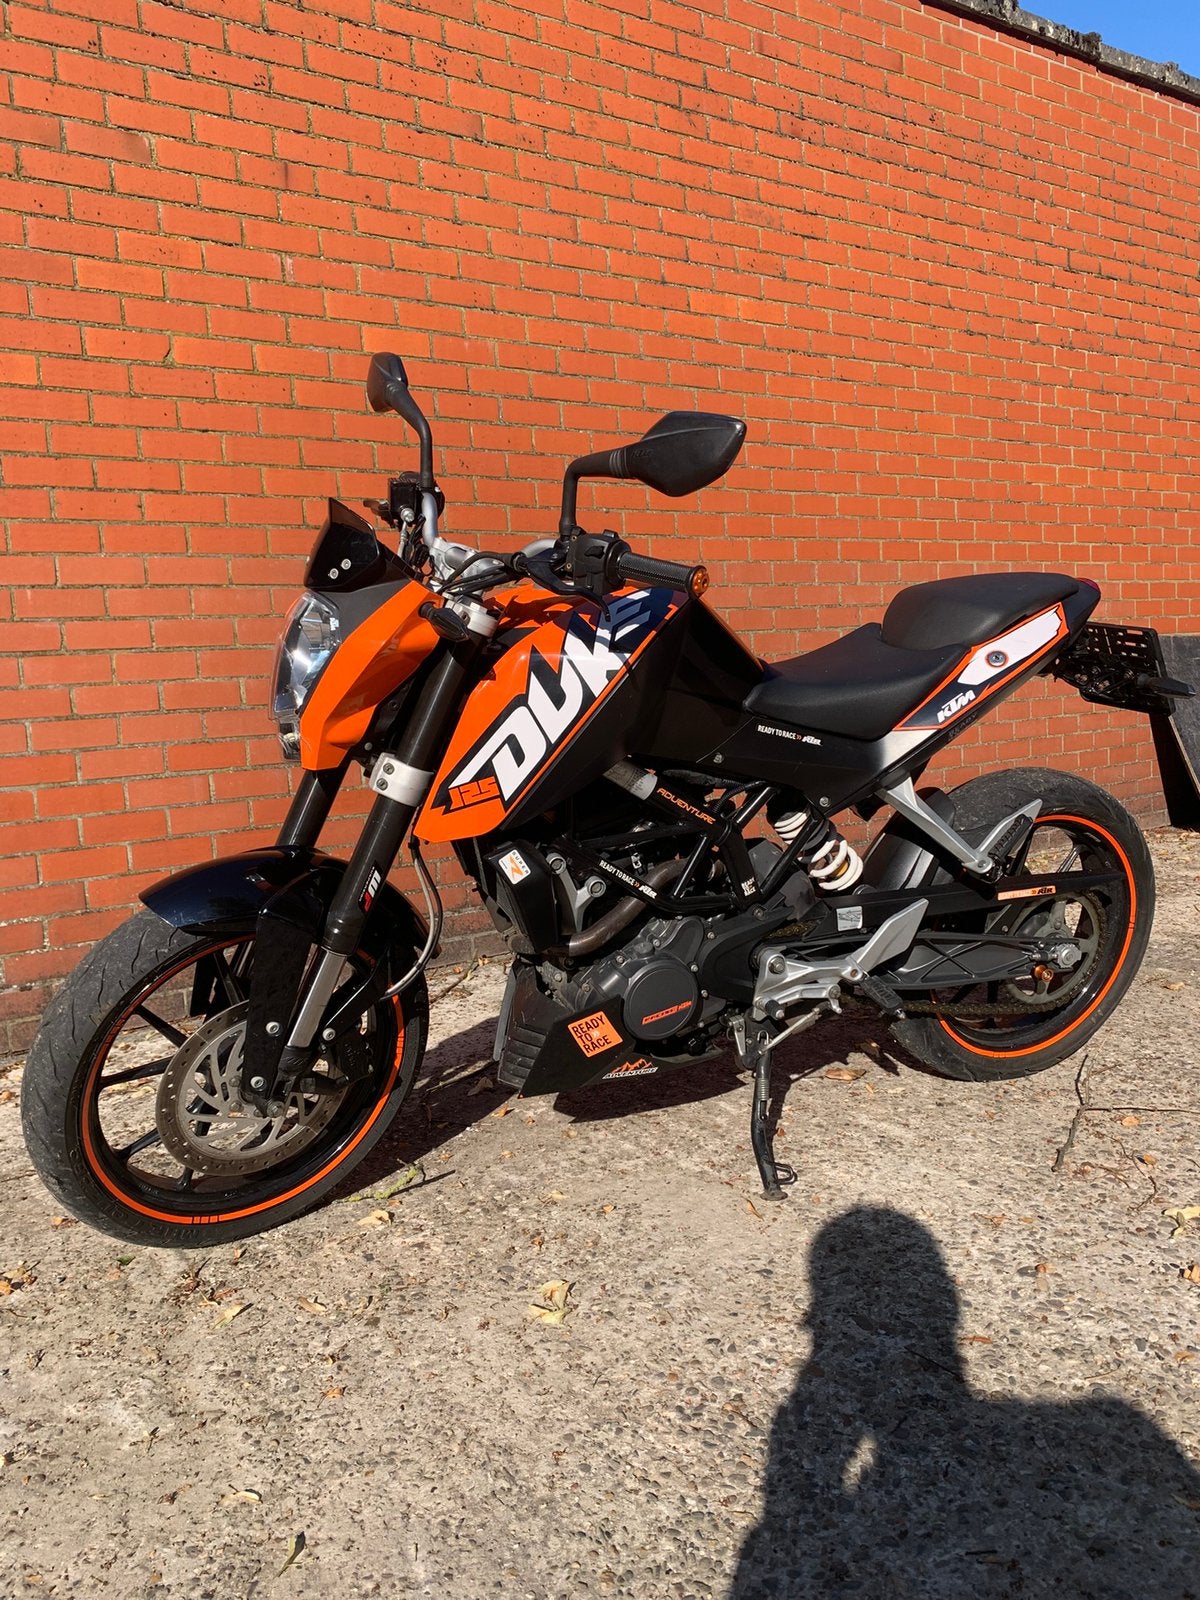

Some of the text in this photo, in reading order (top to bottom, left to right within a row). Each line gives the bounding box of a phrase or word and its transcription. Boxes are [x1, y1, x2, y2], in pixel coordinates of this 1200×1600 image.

[448, 587, 652, 801] DUKE
[936, 689, 976, 723] KTM
[758, 724, 775, 735] READY
[776, 728, 782, 737] TO
[782, 730, 796, 740] RACE
[448, 776, 500, 810] 125
[599, 859, 616, 874] READY
[615, 869, 623, 878] TO
[622, 873, 635, 886] RACE
[571, 1014, 606, 1037] READY
[577, 1032, 594, 1045] TO
[583, 1034, 612, 1053] RACE
